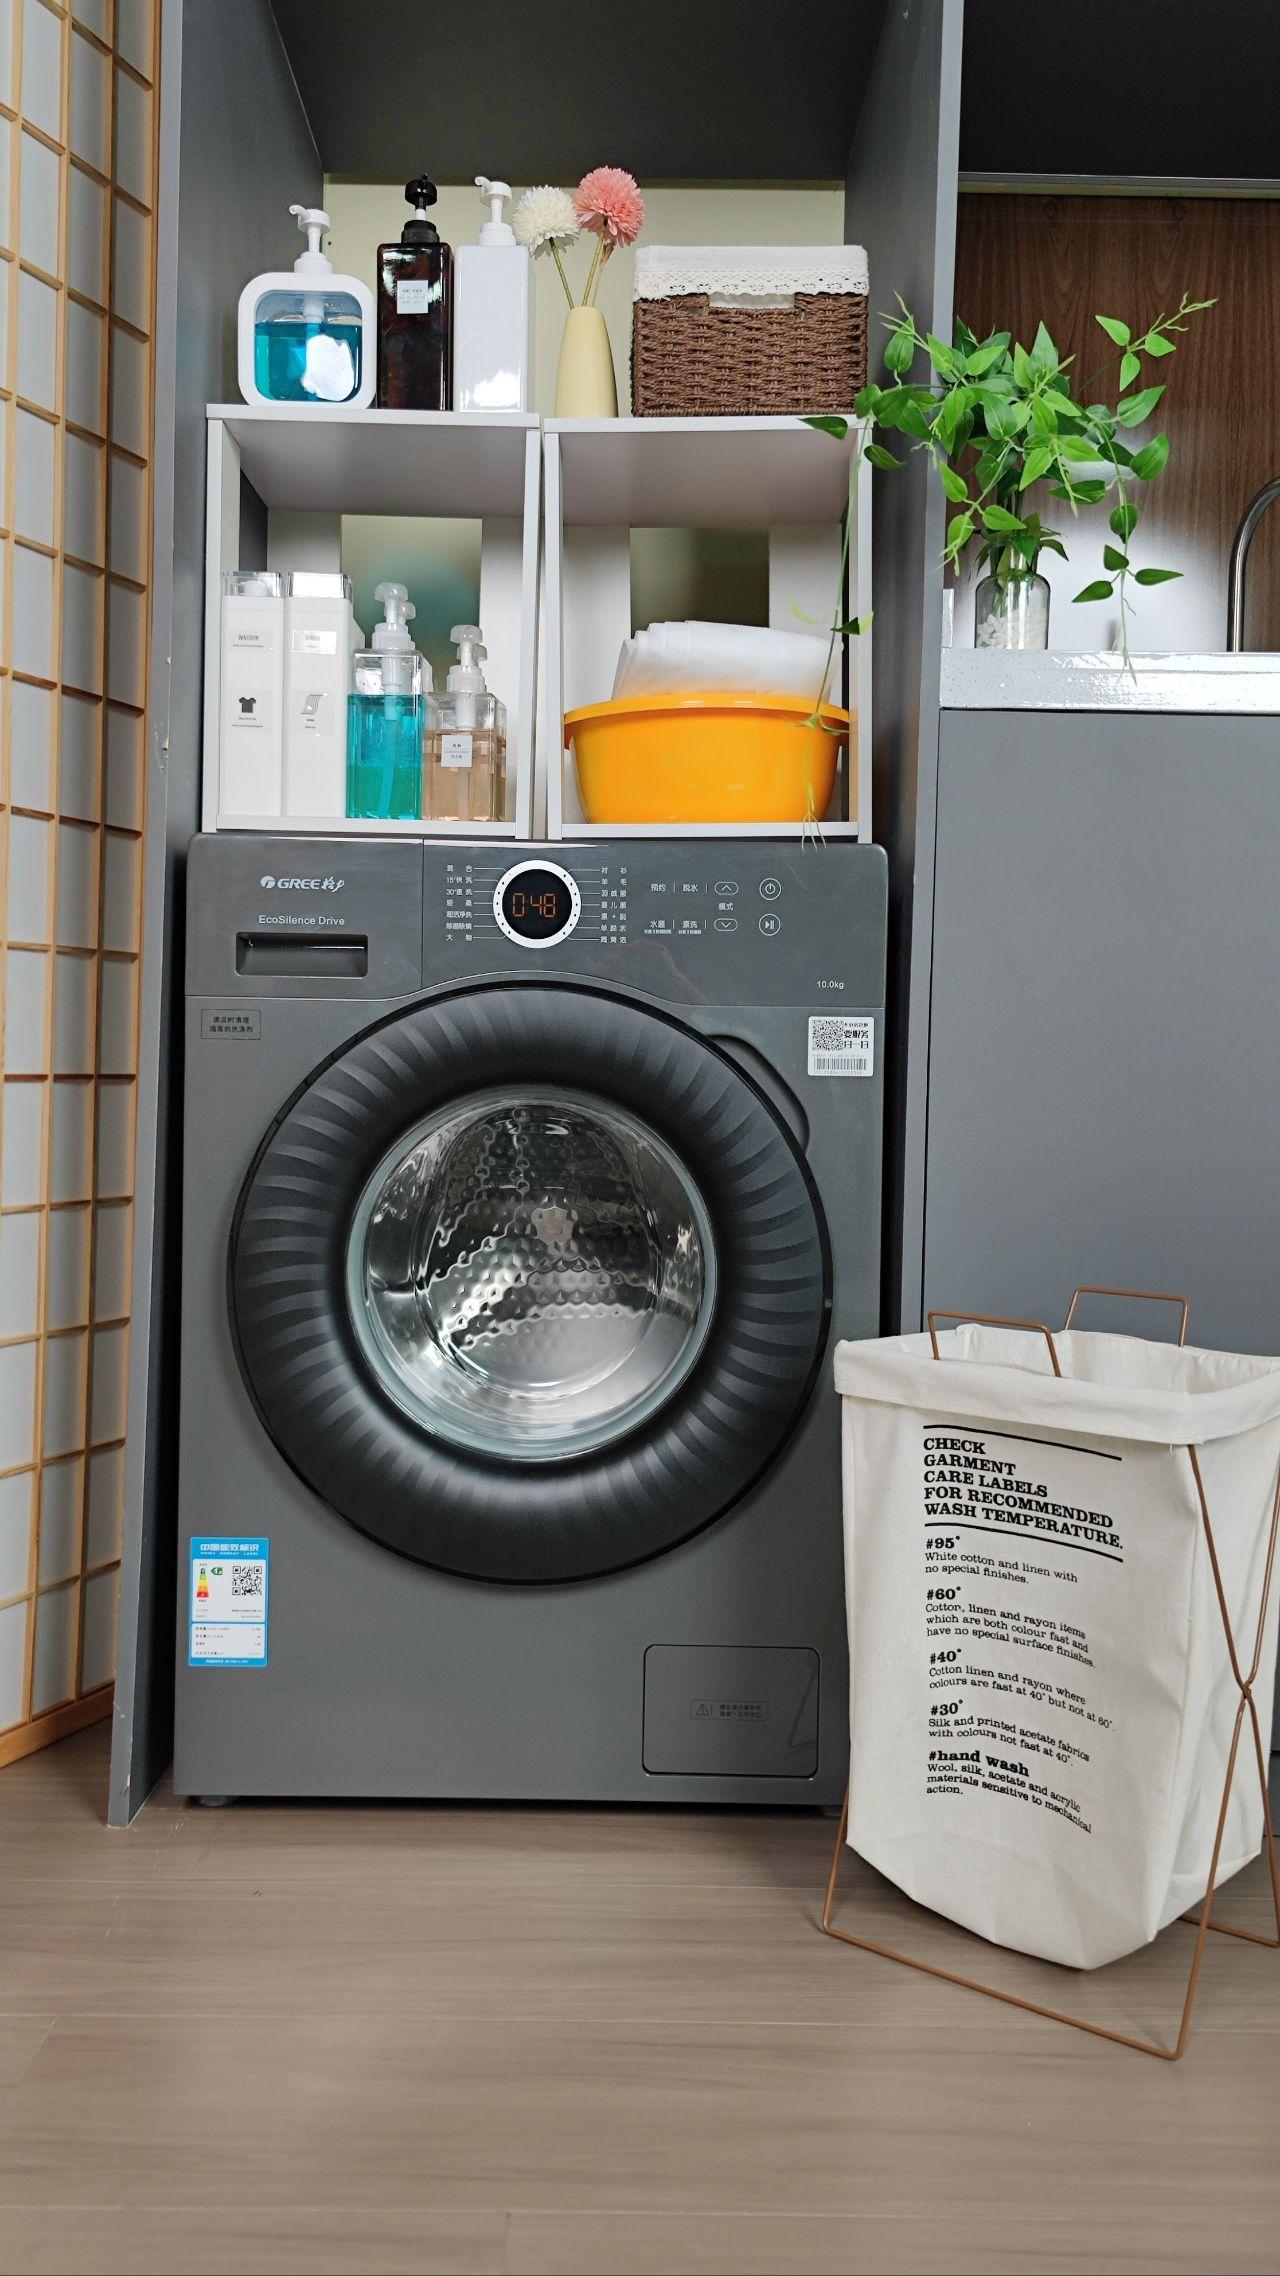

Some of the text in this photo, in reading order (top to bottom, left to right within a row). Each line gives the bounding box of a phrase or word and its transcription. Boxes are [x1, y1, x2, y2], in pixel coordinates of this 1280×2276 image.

[277, 878, 321, 890] GREE
[682, 883, 698, 892] 脱水
[258, 914, 345, 926] EcoSilence Drive
[718, 902, 734, 911] 模式
[816, 981, 845, 990] 10.0kg
[923, 1437, 986, 1455] CHECK
[923, 1453, 1017, 1476] GARMENT
[923, 1470, 1048, 1498] CARE LABELS
[924, 1486, 1114, 1529] FOR RECOMMENDED
[924, 1502, 1123, 1550] WASH TEMPERATURE.
[926, 1535, 961, 1550] #95°
[925, 1552, 1078, 1583] White cotton and linen with
[925, 1564, 1030, 1584] no special finishes.
[926, 1586, 962, 1601] #60°
[926, 1614, 1089, 1653] which are both colour fast and
[968, 1603, 997, 1616] linen
[1000, 1611, 1021, 1621] and
[1023, 1615, 1057, 1629] rayon
[1060, 1622, 1086, 1640] items
[926, 1627, 1096, 1669] have no special surface finishes.
[930, 1648, 962, 1664] #40°
[929, 1665, 1086, 1705] Cotton linen and rayon where
[929, 1678, 968, 1688] colours
[970, 1679, 989, 1688] are
[991, 1681, 1013, 1692] fast
[1016, 1686, 1027, 1696] at
[1048, 1695, 1066, 1709] but
[1068, 1703, 1085, 1717] not
[1086, 1712, 1096, 1723] at
[930, 1699, 963, 1716] #30°
[928, 1715, 1090, 1762] Silk and printed acetate fabrics
[928, 1730, 954, 1738] with
[956, 1728, 997, 1739] colours
[1000, 1733, 1017, 1746] not
[1020, 1738, 1041, 1753] fast
[1043, 1747, 1053, 1757] at
[928, 1750, 1030, 1778] #hand wash
[926, 1785, 964, 1795] action.
[926, 1774, 1092, 1834] materials sensitive to mechanical
[988, 1770, 1027, 1788] acetate
[1028, 1783, 1048, 1796] and
[1050, 1791, 1081, 1813] acrylic
